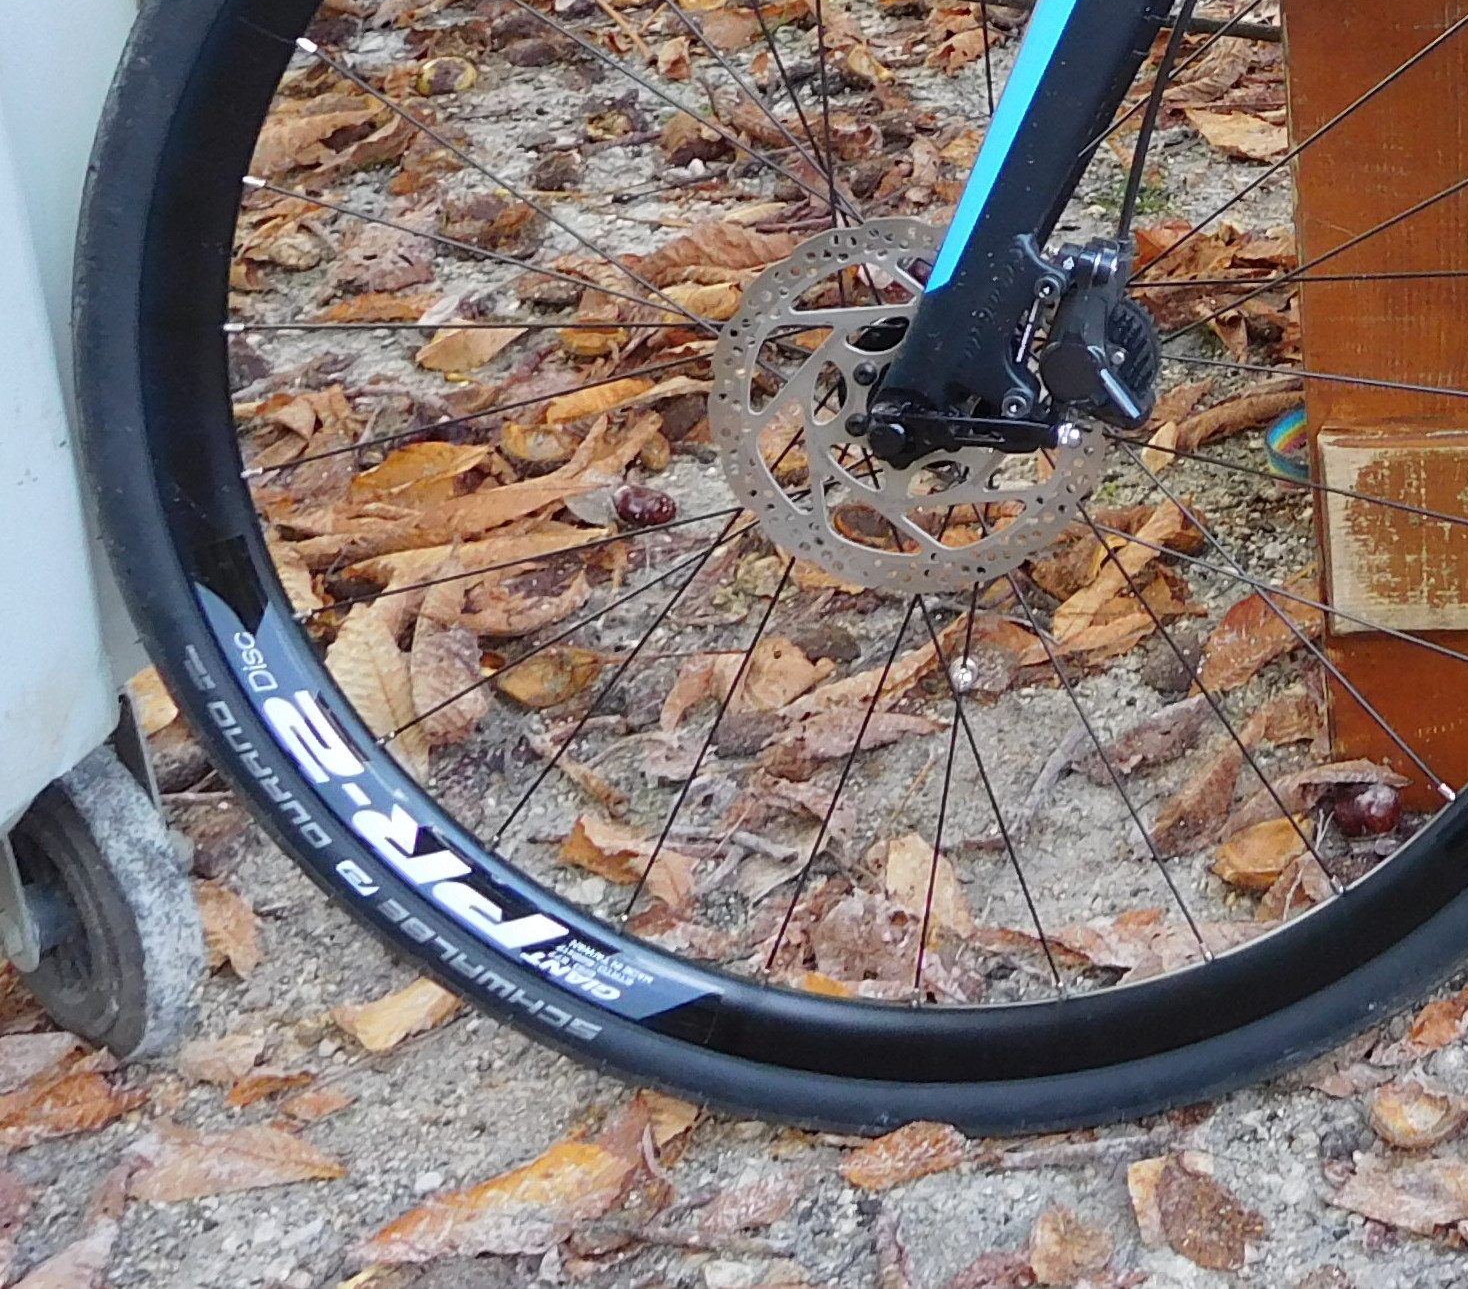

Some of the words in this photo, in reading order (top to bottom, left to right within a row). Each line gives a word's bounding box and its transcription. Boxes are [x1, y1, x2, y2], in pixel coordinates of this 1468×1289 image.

[234, 631, 278, 692] Disc
[206, 700, 333, 849] DURANO
[263, 690, 569, 949] PR-2
[384, 895, 602, 1042] SCHWALBE
[520, 952, 620, 1001] GIANT
